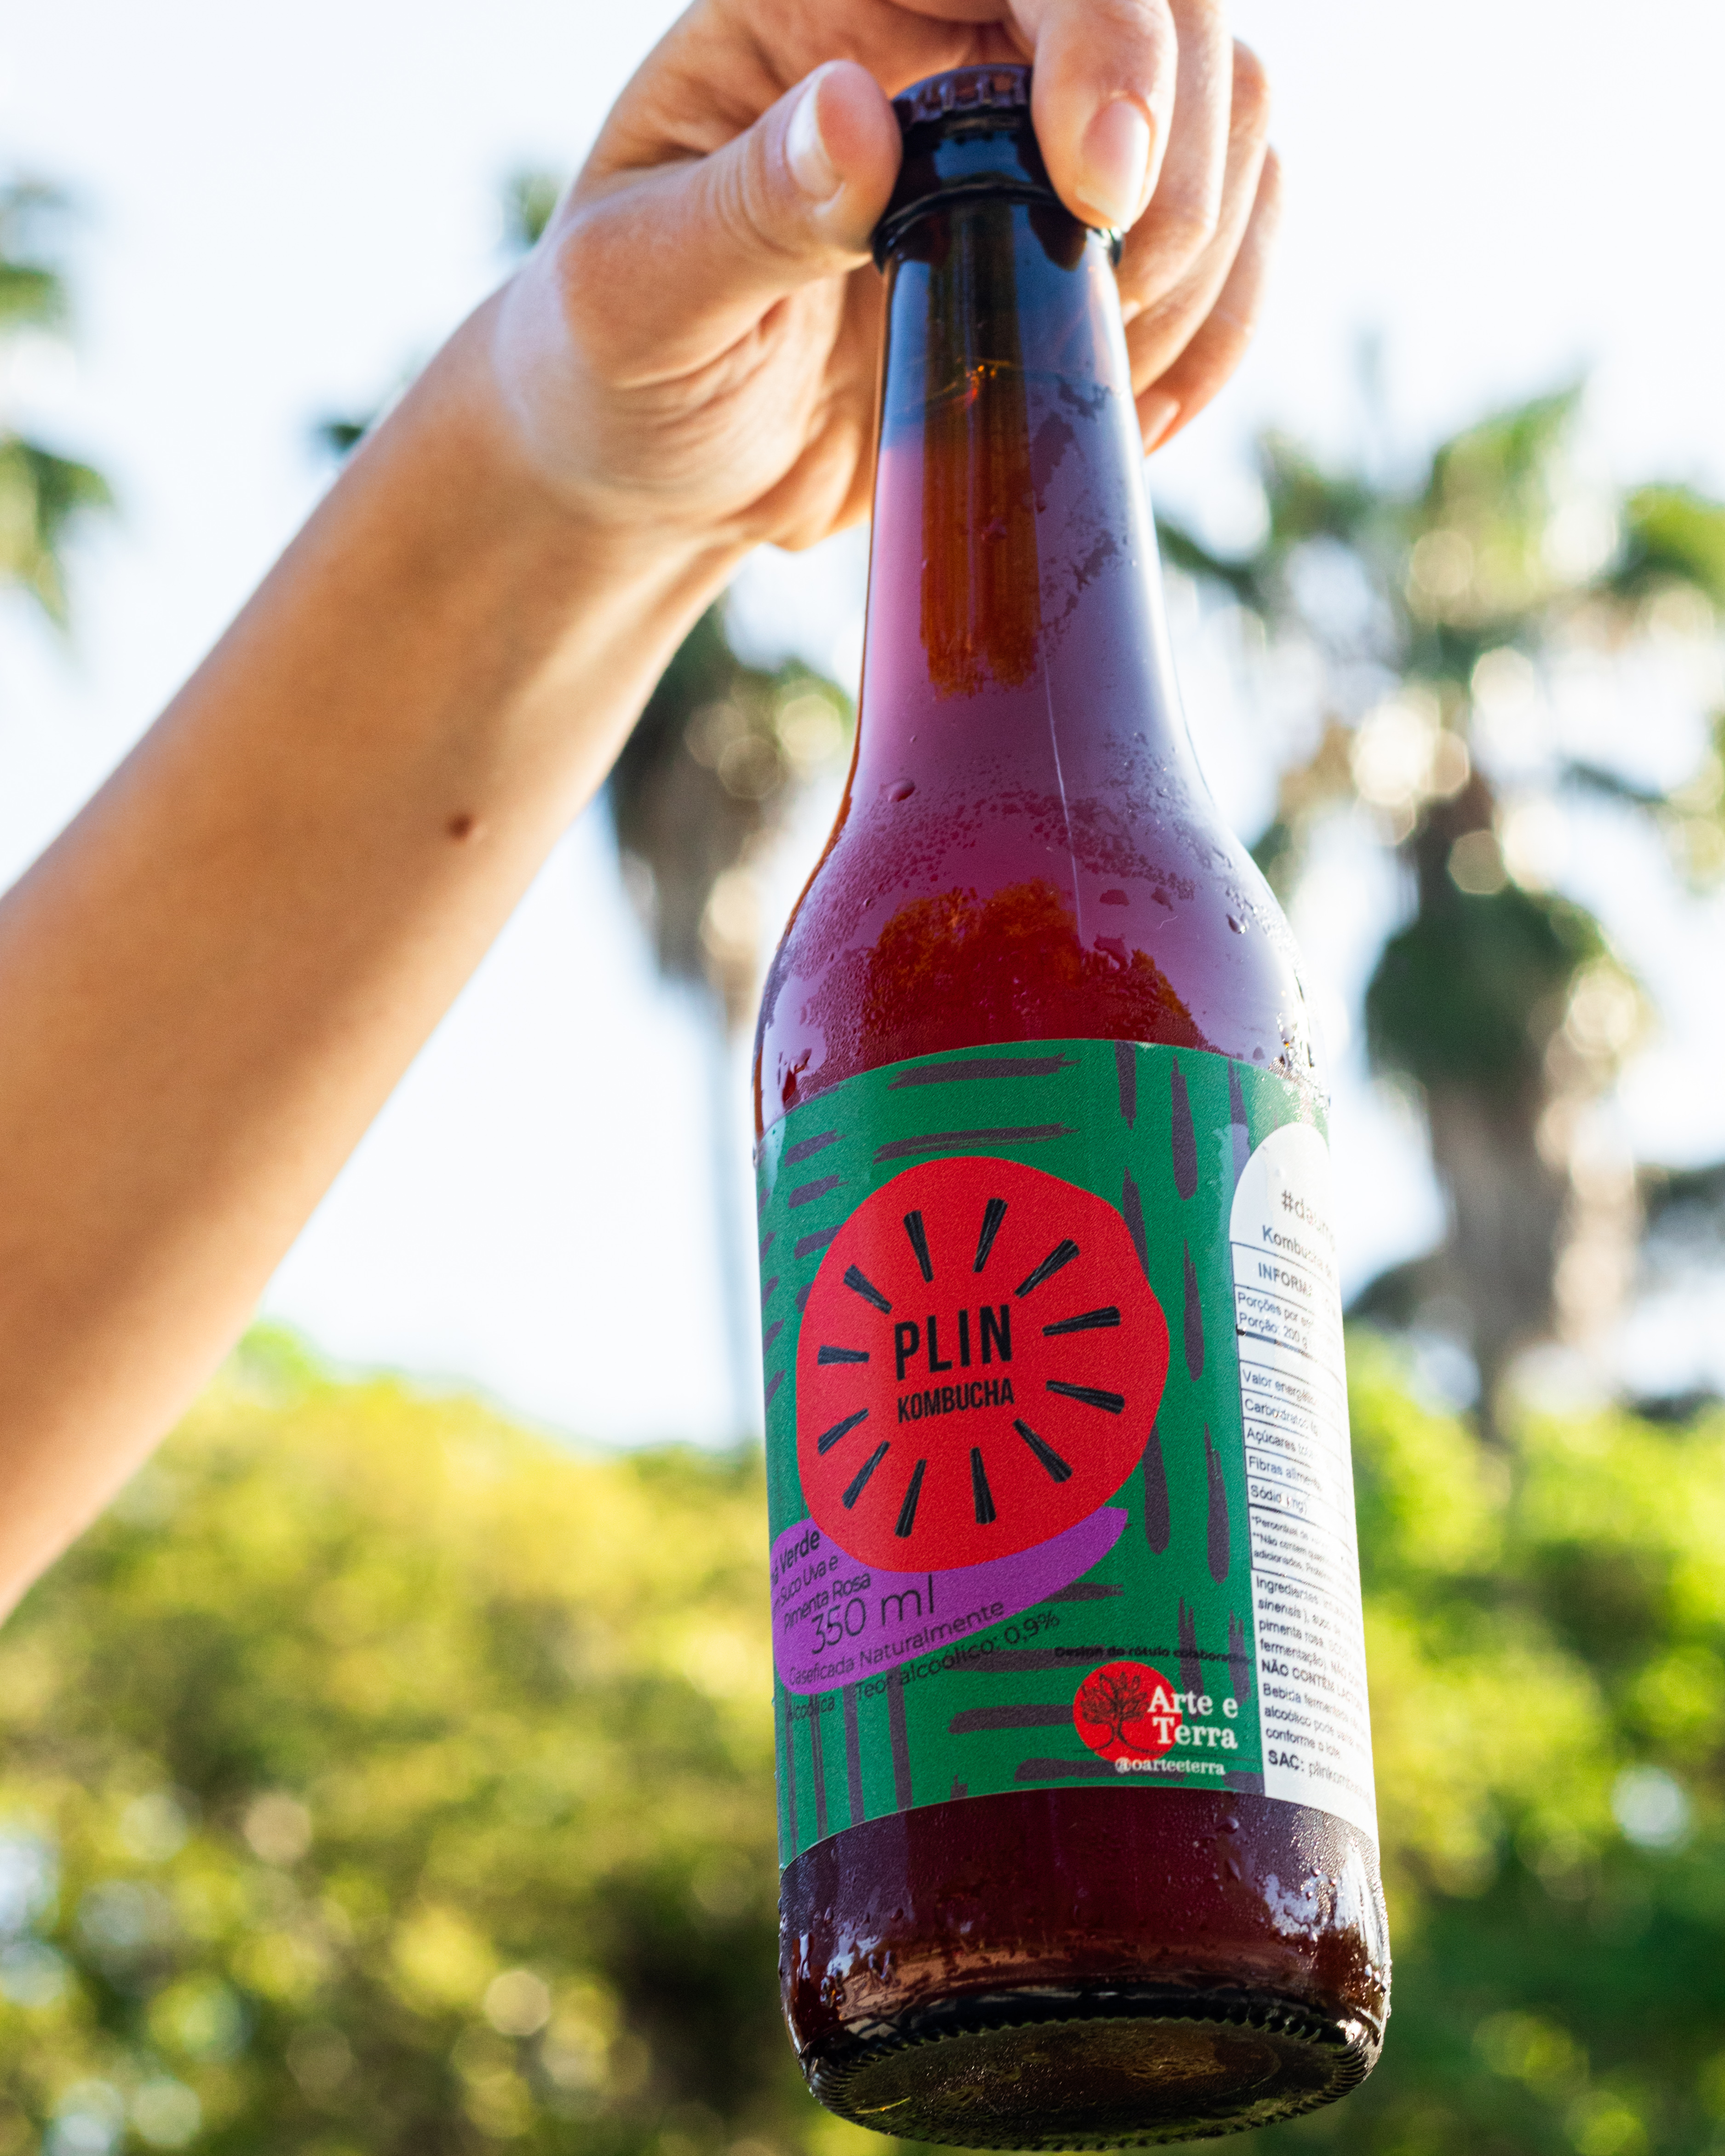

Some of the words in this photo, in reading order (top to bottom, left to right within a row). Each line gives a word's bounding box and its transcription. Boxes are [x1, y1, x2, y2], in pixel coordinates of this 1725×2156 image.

[894, 1303, 1012, 1381] PLIN
[1243, 1370, 1271, 1388] Valor
[897, 1377, 1015, 1424] KOMBUCHA
[1247, 1427, 1295, 1452] Açúcares
[1248, 1456, 1282, 1475] Fibras
[1251, 1485, 1281, 1503] Sódio
[780, 1529, 820, 1574] Verde
[829, 1555, 839, 1571] e
[832, 1572, 871, 1601] Rosa
[811, 1597, 866, 1654] 350
[881, 1573, 934, 1626] ml
[860, 1601, 1004, 1666] Naturalmente
[1259, 1619, 1301, 1642] pimenta
[855, 1675, 893, 1701] Teor
[900, 1642, 1001, 1685] alcoólico:
[1004, 1611, 1060, 1645] 0,9%
[1262, 1658, 1288, 1677] NÃO
[1147, 1685, 1213, 1715] Arte
[1222, 1697, 1239, 1719] e
[1264, 1683, 1301, 1704] Bebida
[1152, 1716, 1238, 1749] Terra
[1265, 1726, 1315, 1748] conforme
[1114, 1756, 1226, 1776] @oarteeterra
